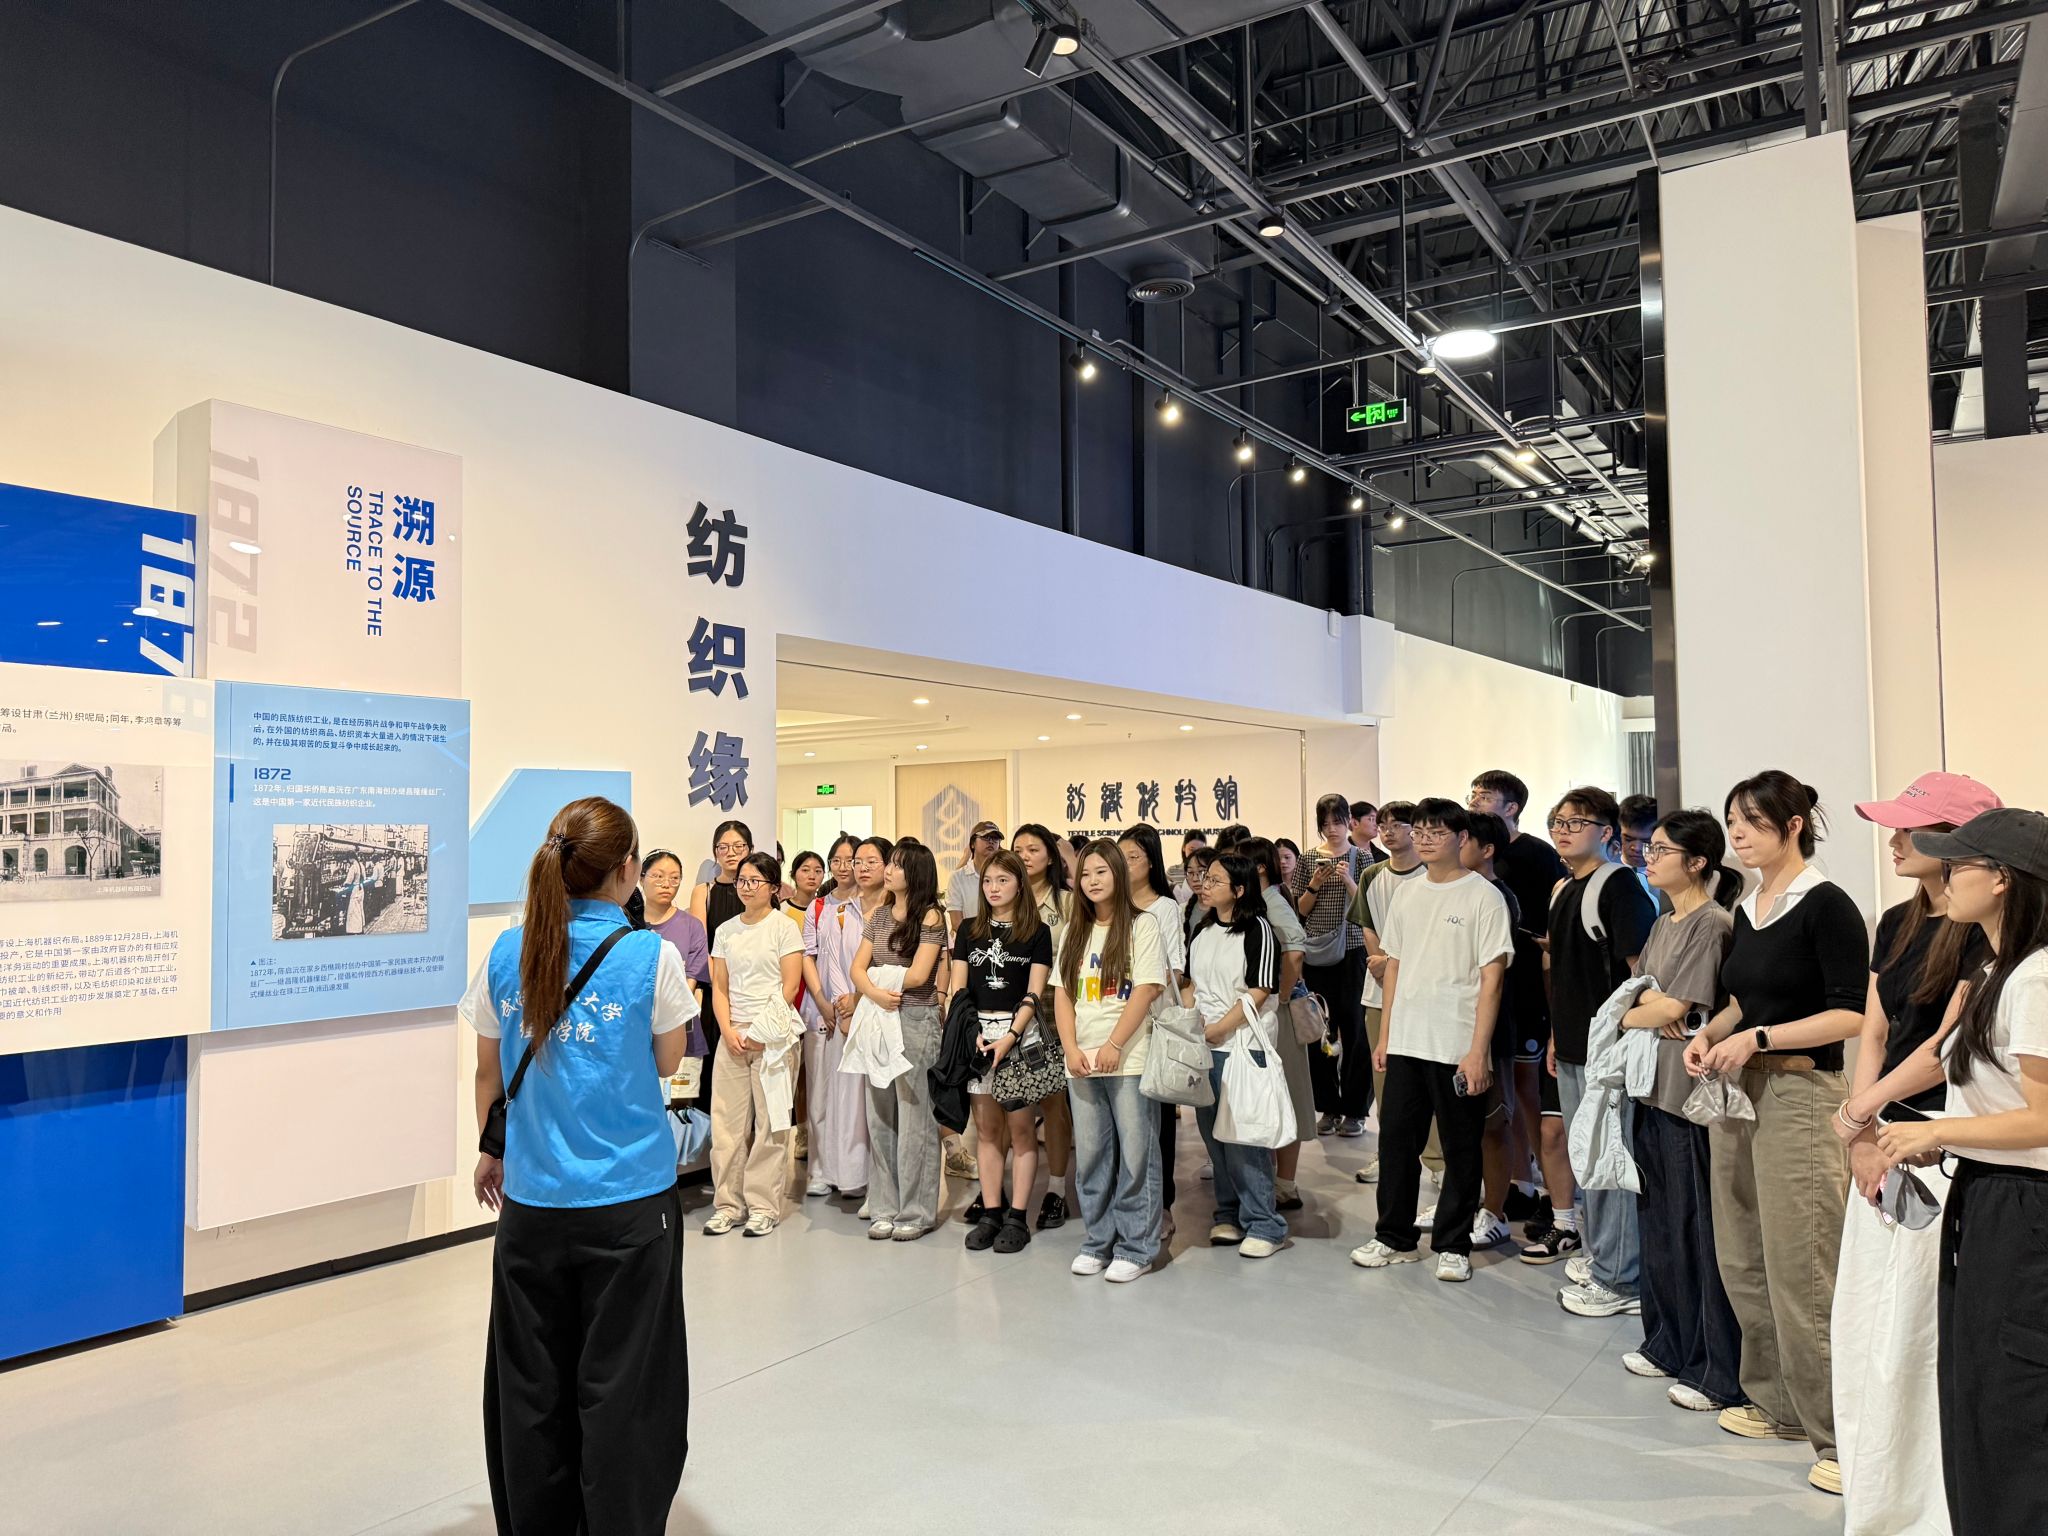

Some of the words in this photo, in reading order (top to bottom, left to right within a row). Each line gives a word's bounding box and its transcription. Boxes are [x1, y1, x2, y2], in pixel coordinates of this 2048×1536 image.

[346, 485, 363, 572] SOURCE
[368, 490, 383, 559] TRACE
[392, 494, 436, 603] 溯源
[367, 564, 383, 591] TO
[367, 597, 382, 637] THE
[686, 501, 749, 812] 纺织缘
[254, 767, 292, 781] 1872
[1067, 829, 1096, 837] TEXTILE
[1096, 829, 1124, 837] SCIENC
[0, 953, 177, 972] 洋务运动的重要成果。上海机器织布局开创了
[0, 986, 178, 1008] 国近代纺织工业的初步发展奠定了基础，在中
